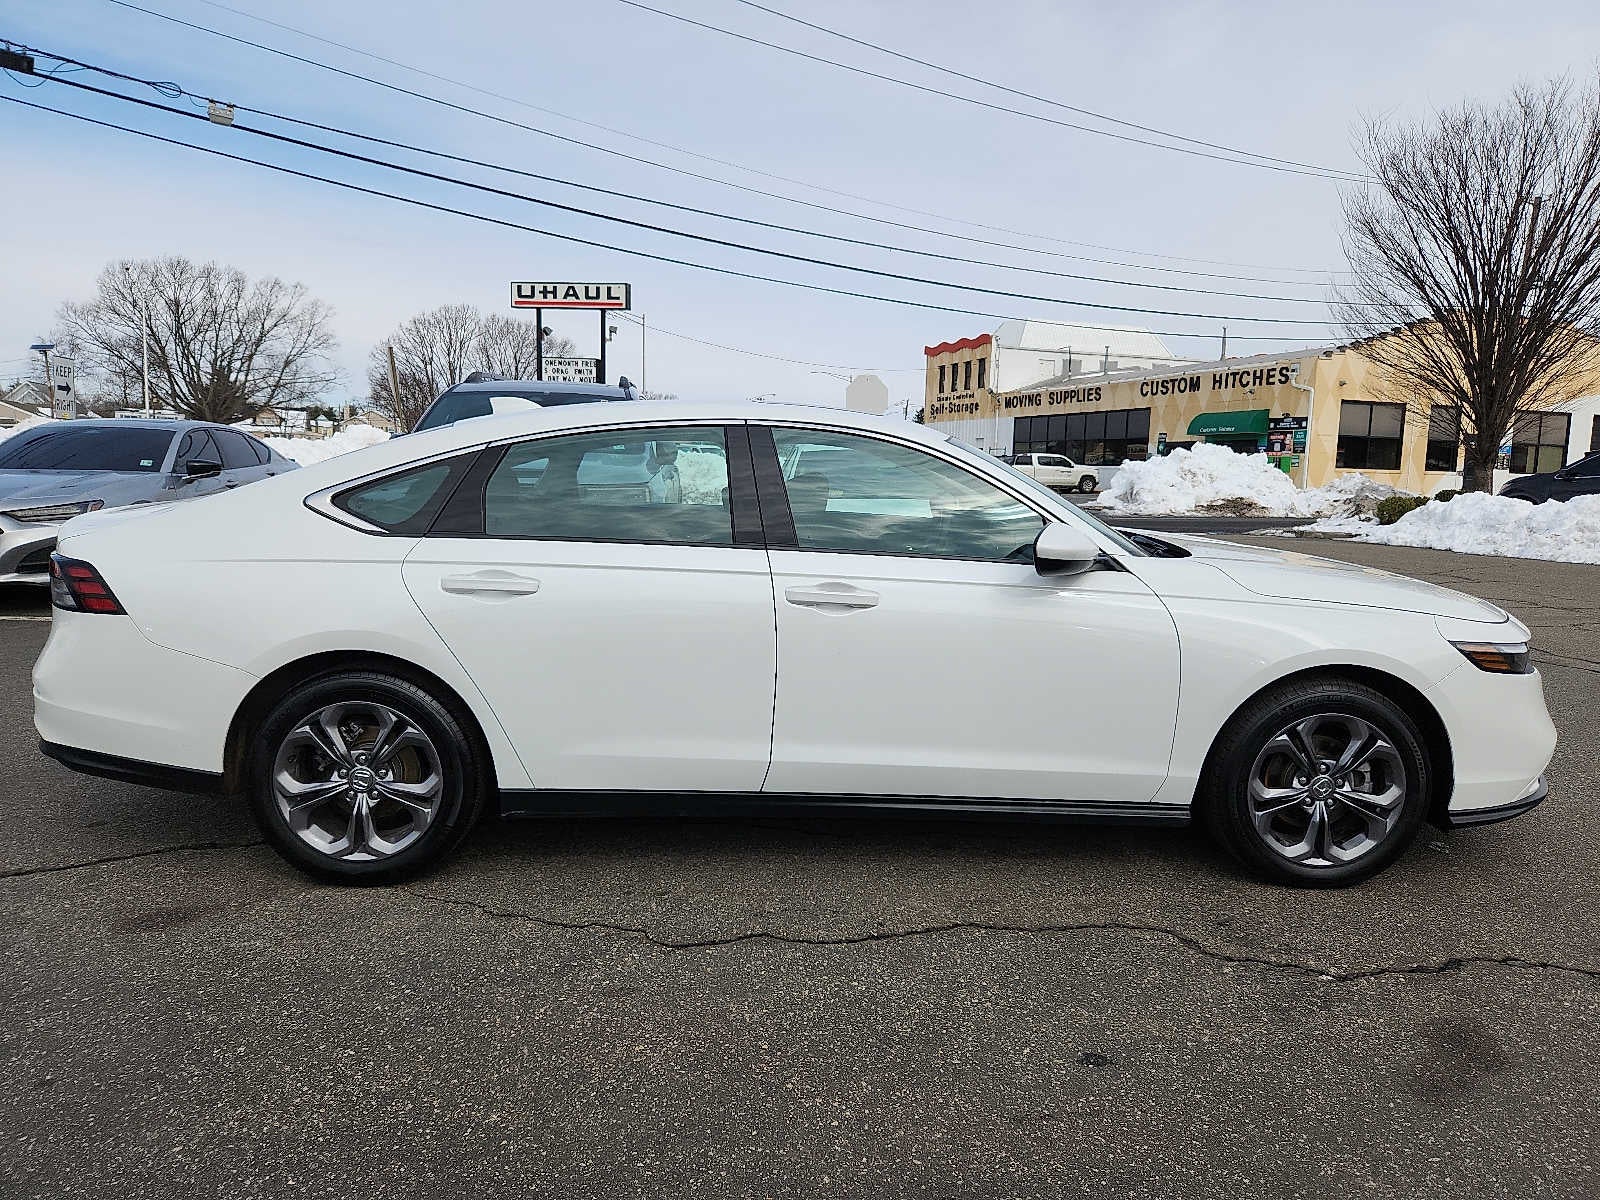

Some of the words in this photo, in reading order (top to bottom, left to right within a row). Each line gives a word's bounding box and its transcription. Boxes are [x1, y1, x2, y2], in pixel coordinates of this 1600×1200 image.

[55, 365, 71, 378] KEEP
[1140, 376, 1200, 397] CUSTOM
[1212, 366, 1290, 390] HITCHES
[56, 398, 74, 411] RIGHT
[1004, 393, 1041, 410] MOVING
[1048, 386, 1102, 406] SUPPLIES
[930, 401, 980, 415] Self-Storage
